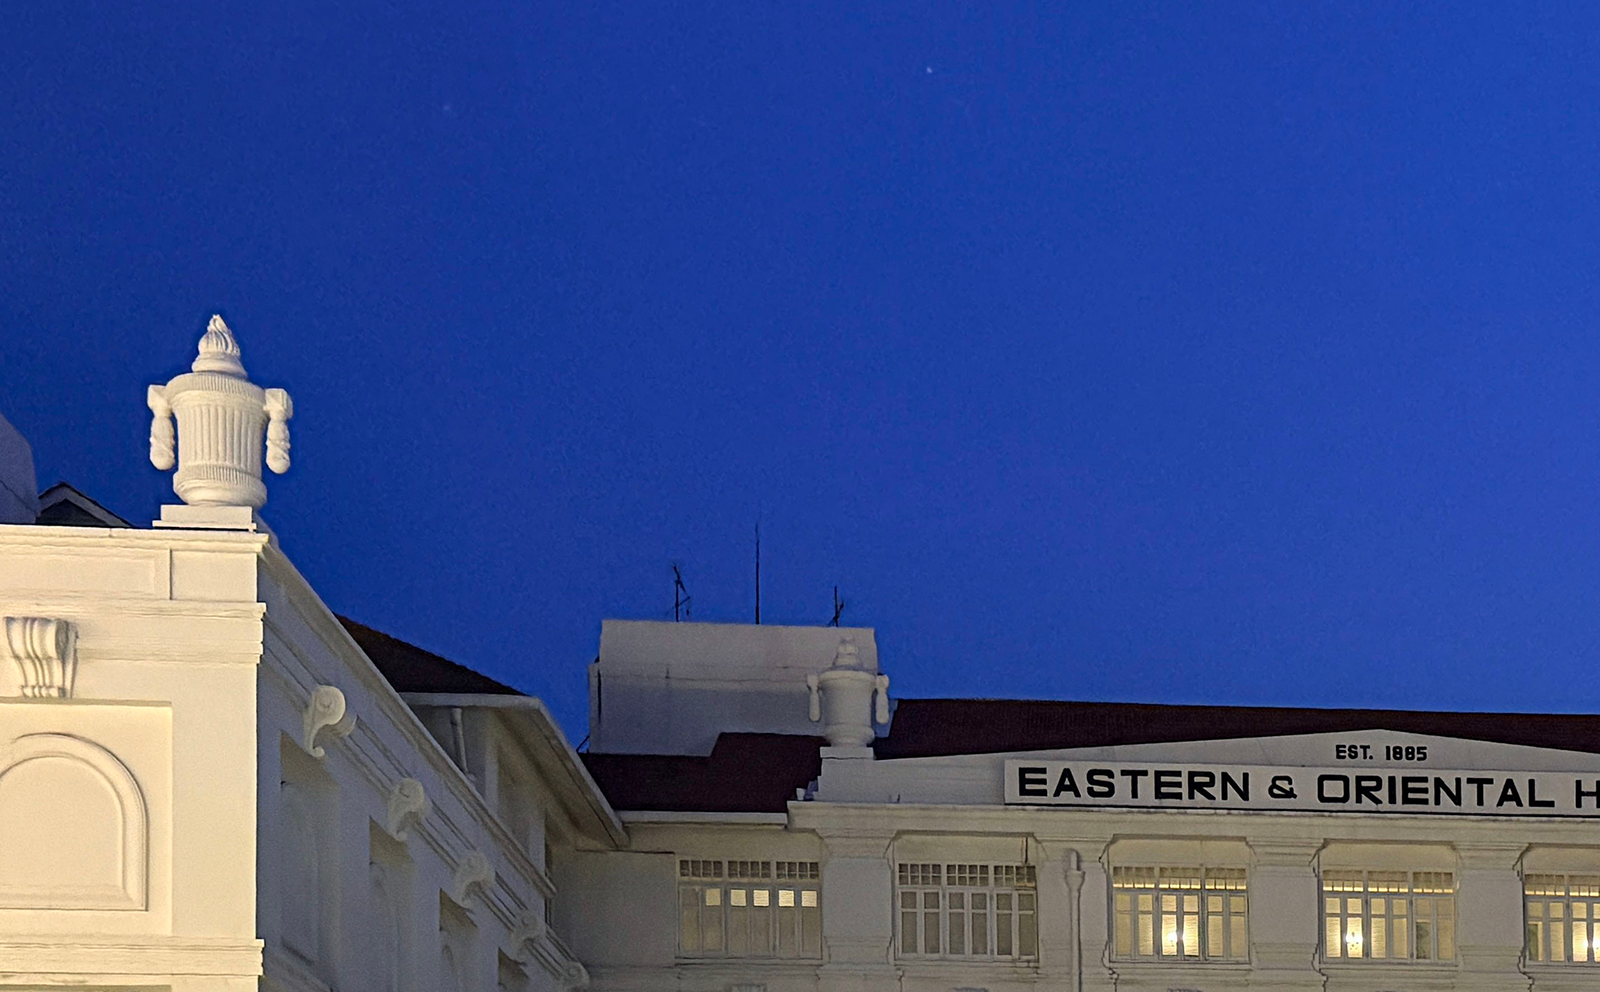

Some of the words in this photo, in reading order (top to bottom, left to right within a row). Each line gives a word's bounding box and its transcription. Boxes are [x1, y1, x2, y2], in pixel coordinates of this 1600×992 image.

[1335, 744, 1375, 761] EST.
[1384, 744, 1428, 762] 1885
[1018, 766, 1251, 802] EASTERN
[1267, 774, 1298, 801] &
[1317, 774, 1556, 808] ORIENTAL
